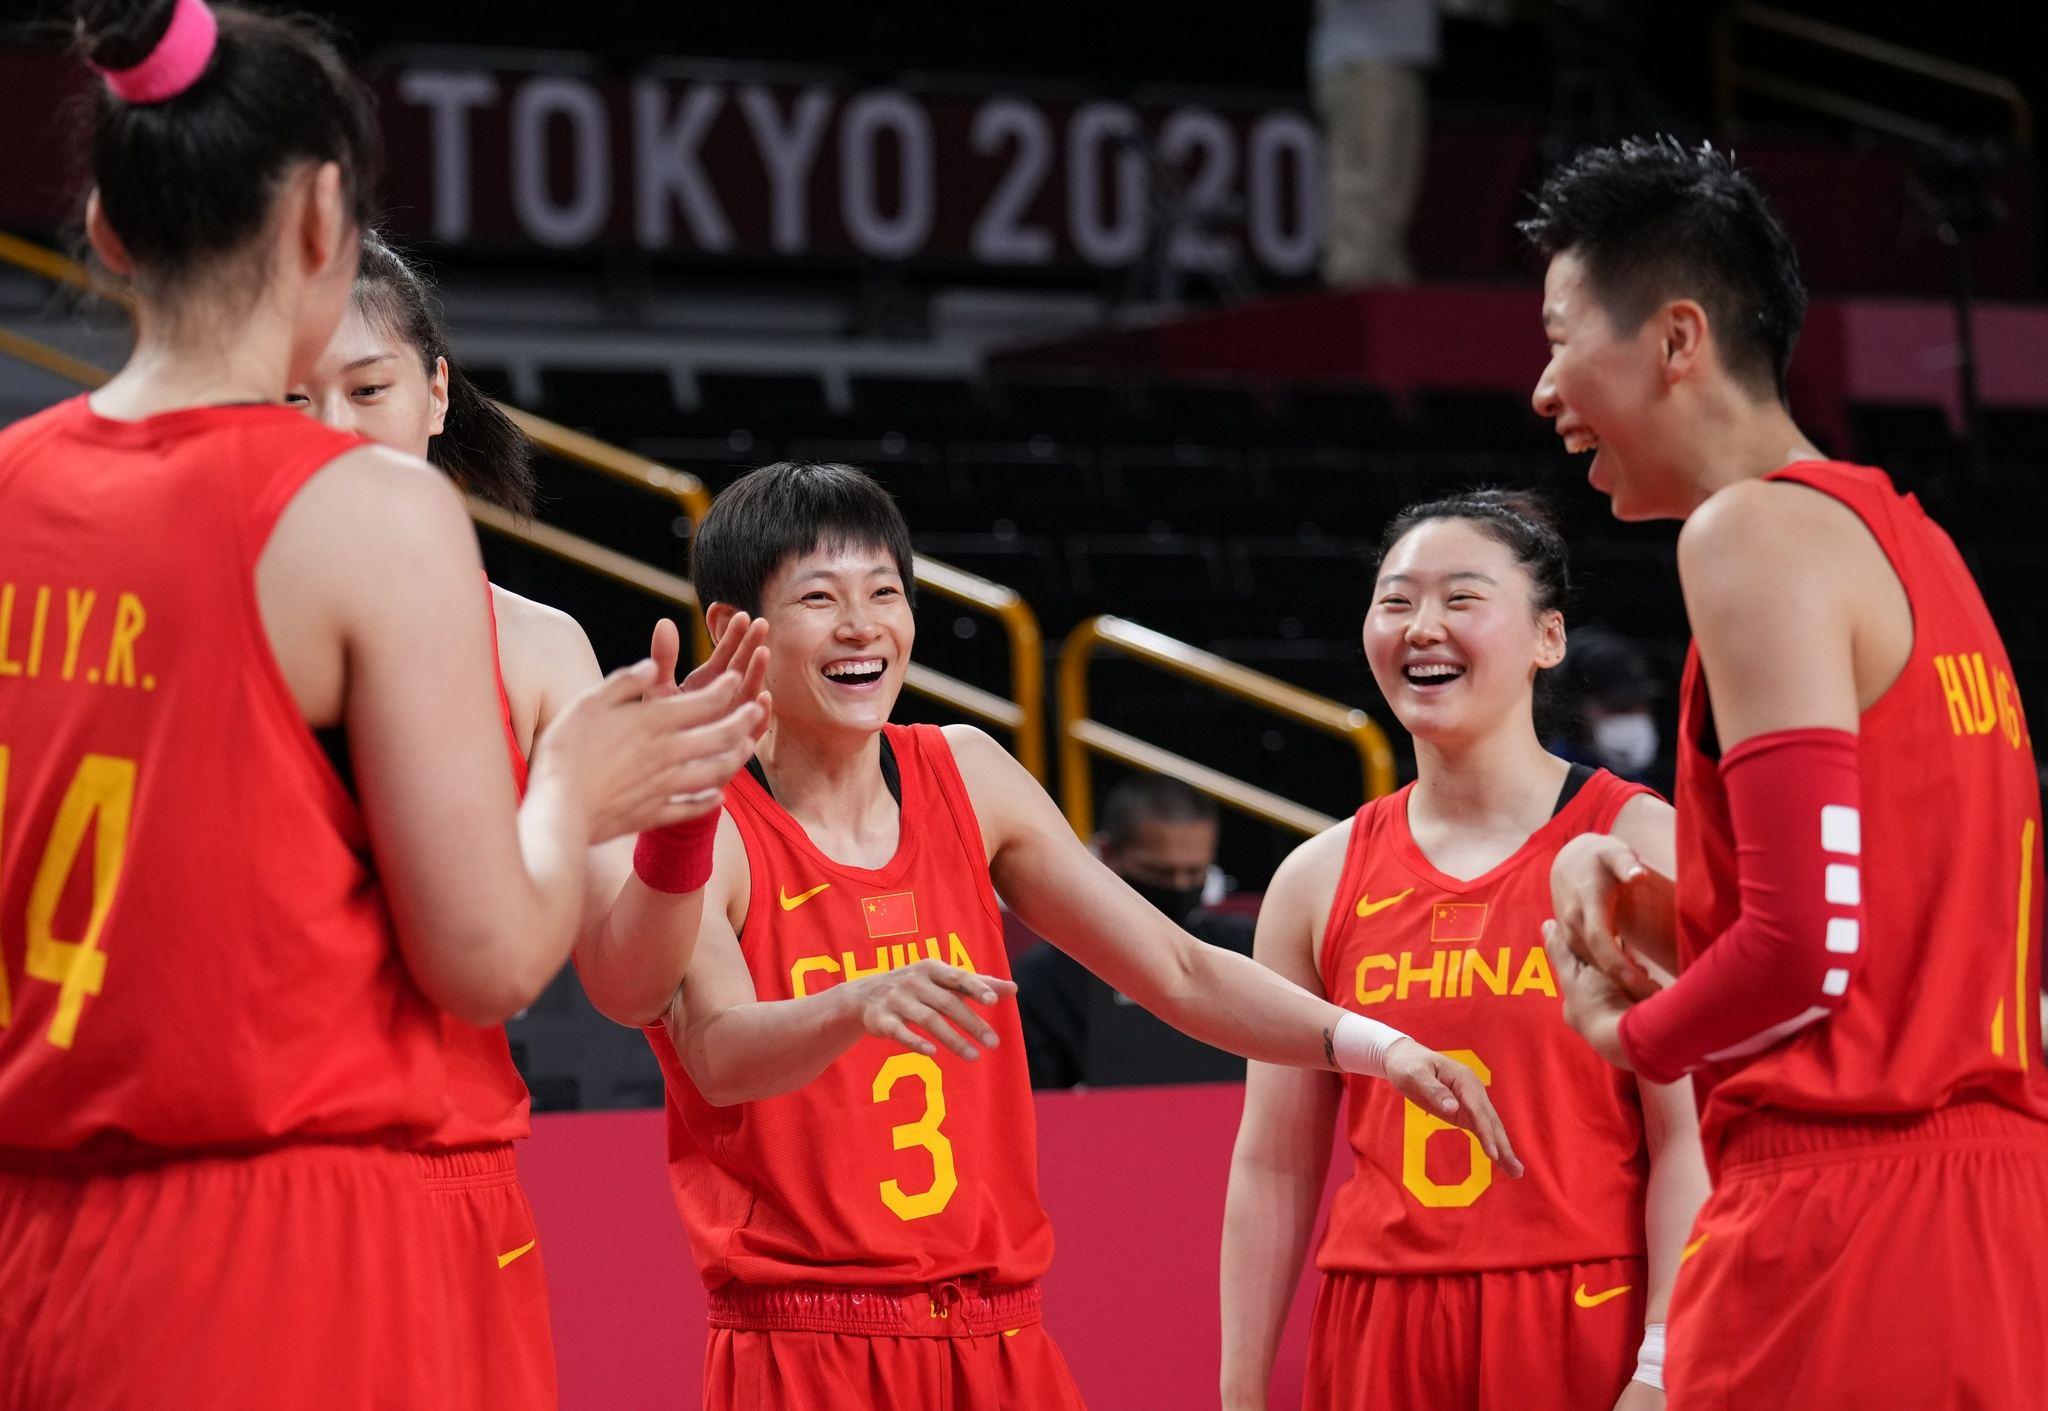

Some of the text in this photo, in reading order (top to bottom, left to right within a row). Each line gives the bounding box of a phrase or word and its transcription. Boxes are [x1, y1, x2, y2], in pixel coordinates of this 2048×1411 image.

[400, 70, 1324, 272] TOKYO 2020
[1355, 946, 1557, 1006] CHINA
[872, 1051, 958, 1222] 3
[1402, 1048, 1493, 1208] 6
